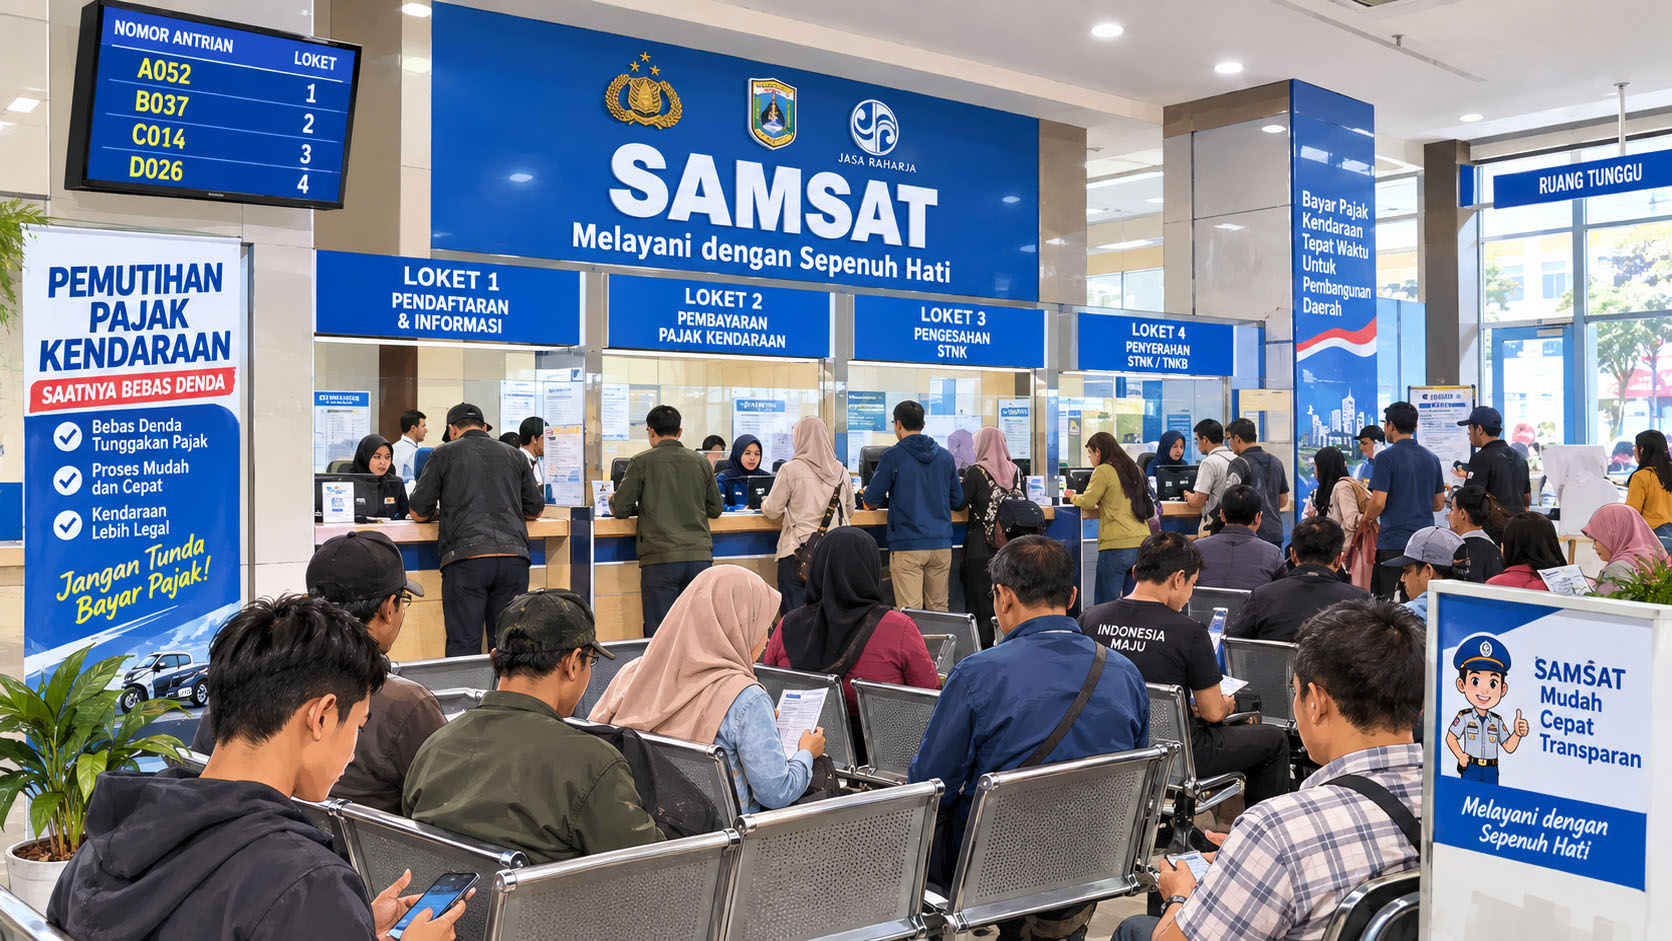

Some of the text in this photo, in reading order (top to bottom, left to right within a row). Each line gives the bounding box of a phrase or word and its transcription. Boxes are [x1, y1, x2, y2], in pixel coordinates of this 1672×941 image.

[114, 19, 233, 53] NOMOR ANTRIAN
[137, 57, 192, 85] A052
[294, 51, 337, 70] LOKET
[135, 90, 190, 117] B037
[305, 83, 317, 103] 1
[302, 113, 315, 134] 2
[132, 123, 186, 150] C014
[300, 144, 311, 164] 3
[838, 153, 917, 173] JASA RAHARJA
[129, 156, 183, 182] D026
[1539, 162, 1642, 195] RUANG TUNGGU
[297, 174, 309, 194] 4
[609, 142, 939, 249] SAMSAT
[1302, 190, 1369, 221] Bayar Pajak
[1302, 211, 1363, 239] Kendaraan
[572, 222, 951, 284] Melayani dengan Sepenuh Hati
[1302, 233, 1369, 259] Tepat Waktu
[1302, 254, 1336, 276] Untuk
[48, 262, 223, 298] PEMUTIHAN
[404, 266, 500, 291] LOKET 1
[1303, 276, 1371, 300] Pembangunan
[392, 292, 509, 315] PENDAFTARAN
[685, 287, 762, 310] LOKET 2
[1303, 297, 1342, 317] Daerah
[89, 298, 189, 333] PAJAK
[397, 312, 502, 334] & INFORMASI
[677, 311, 768, 331] PEMBAYARAN
[921, 306, 986, 326] LOKET 3
[659, 327, 786, 349] PAJAK KENDARAAN
[914, 327, 990, 345] PENGESAHAN
[1132, 322, 1186, 340] LOKET 4
[39, 330, 231, 373] KENDARAAN
[937, 344, 967, 359] STNK
[1126, 340, 1190, 356] PENYERAHAN
[1127, 355, 1188, 370] STNK / TNKB
[41, 373, 226, 405] SAATNYA BEBAS DENDA
[92, 418, 182, 434] Bebas Denda
[92, 433, 208, 454] Tunggakan Pajak
[92, 459, 189, 478] Proses Mudah
[92, 478, 163, 496] dan Cepat
[92, 505, 167, 522] Kendaraan
[92, 520, 170, 540] Lebih Legal
[56, 533, 205, 602] Jangan Tunda
[74, 555, 212, 625] Bayar Pajak!
[1097, 624, 1165, 642] INDONESIA
[1110, 638, 1146, 652] MAJU
[1540, 686, 1602, 713] Mudah
[1540, 709, 1595, 736] Cepat
[1539, 733, 1642, 769] Transparan
[1461, 796, 1609, 839] Melayani dengan
[1479, 824, 1548, 853] Sepenuh
